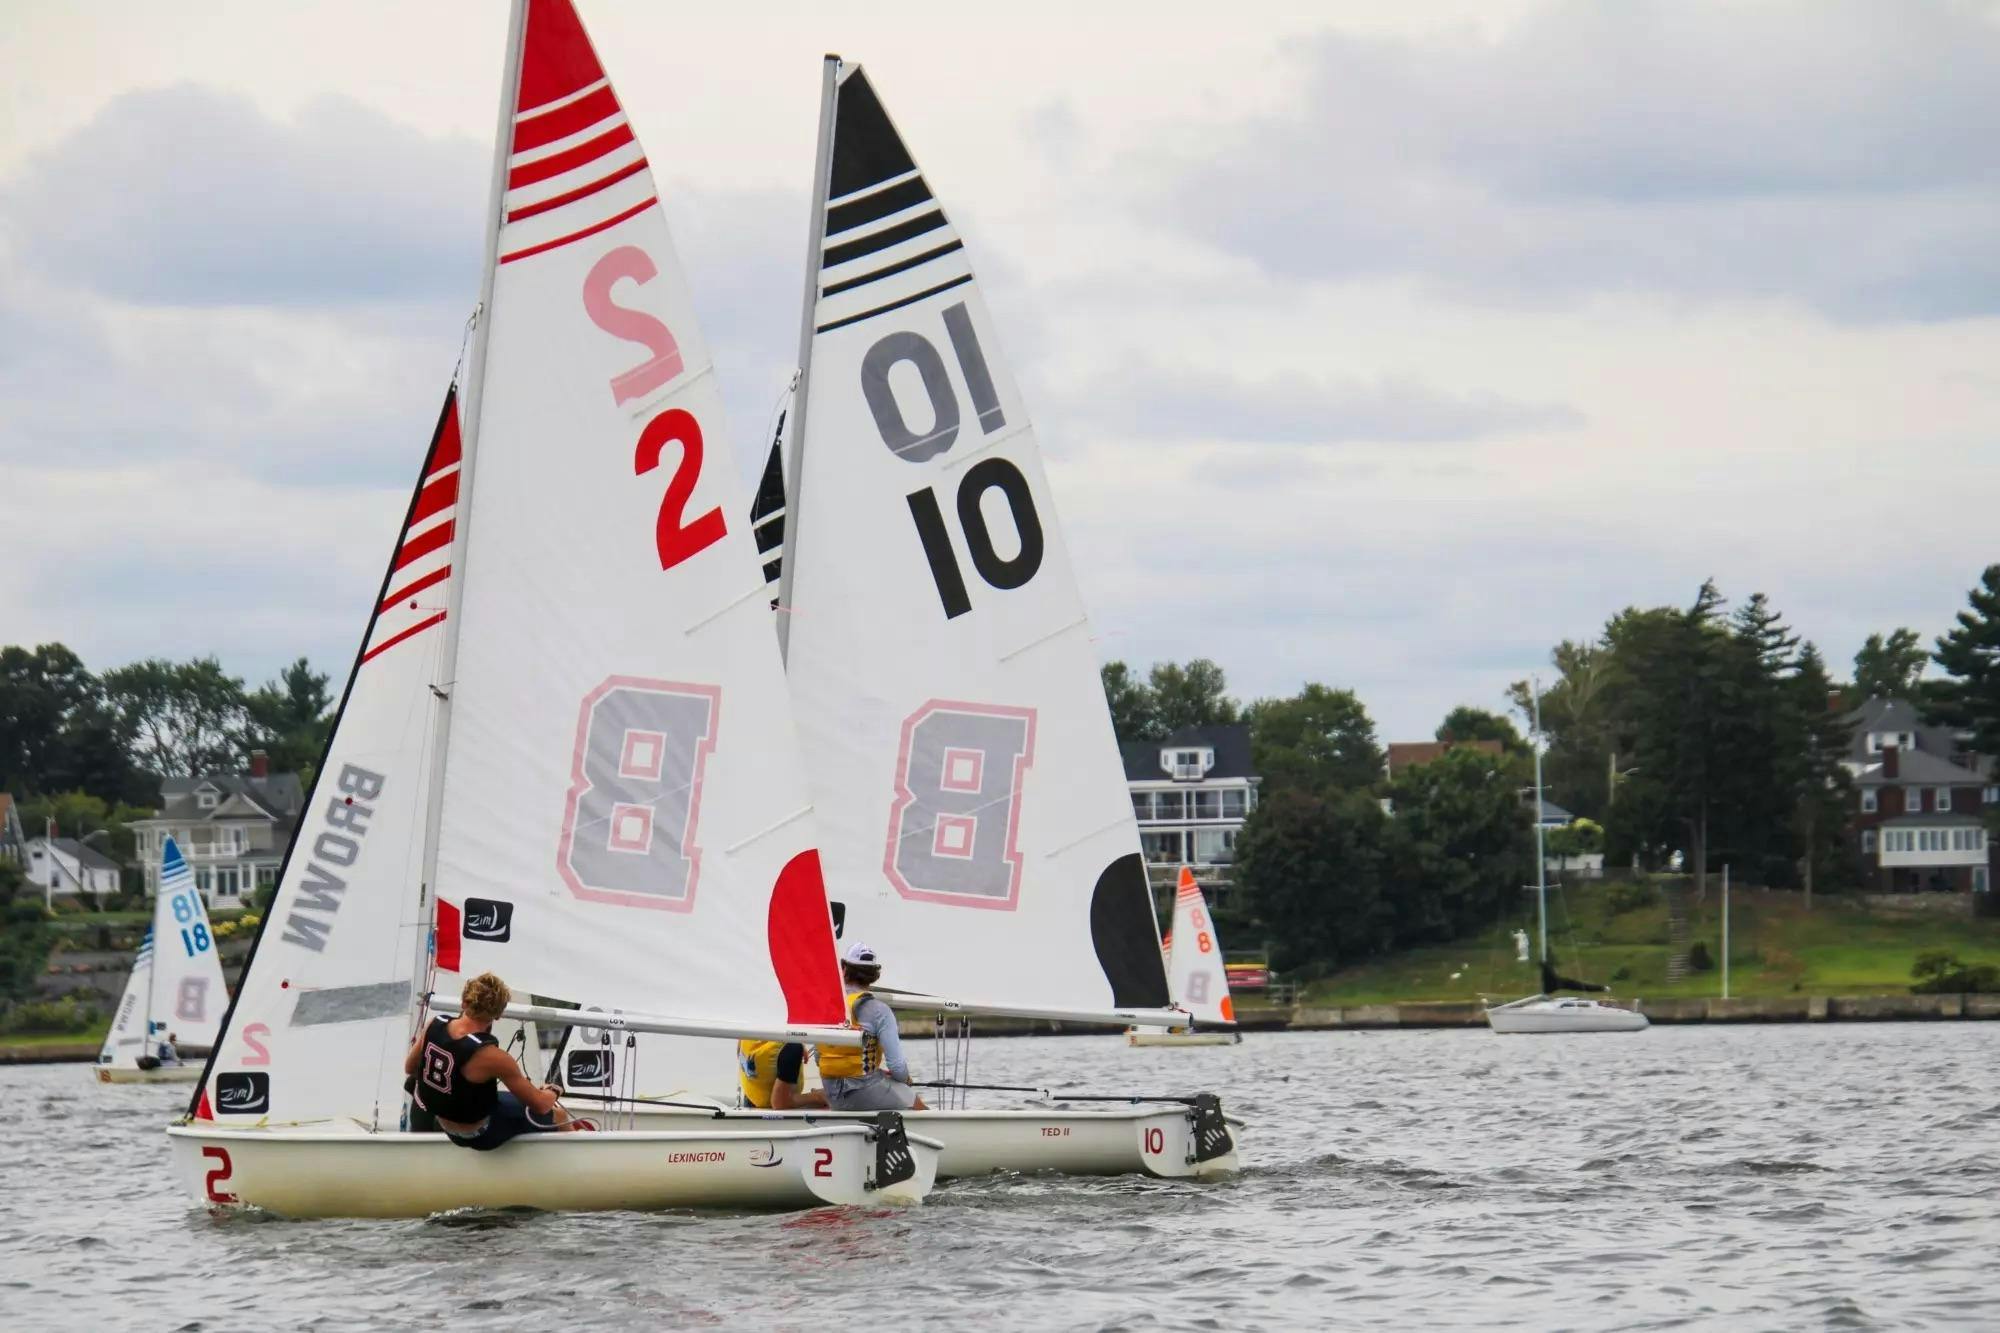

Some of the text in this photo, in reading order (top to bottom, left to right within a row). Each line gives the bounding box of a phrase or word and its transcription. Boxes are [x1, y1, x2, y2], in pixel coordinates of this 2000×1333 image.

[634, 408, 728, 571] 2
[906, 457, 1044, 620] 10
[181, 922, 210, 957] 18
[1198, 932, 1211, 953] 8
[423, 1042, 455, 1094] B
[1041, 1127, 1070, 1137] TED II
[1144, 1127, 1164, 1154] 10
[667, 1151, 726, 1164] LEXINGTON
[814, 1147, 833, 1178] 2
[201, 1146, 236, 1203] 2
